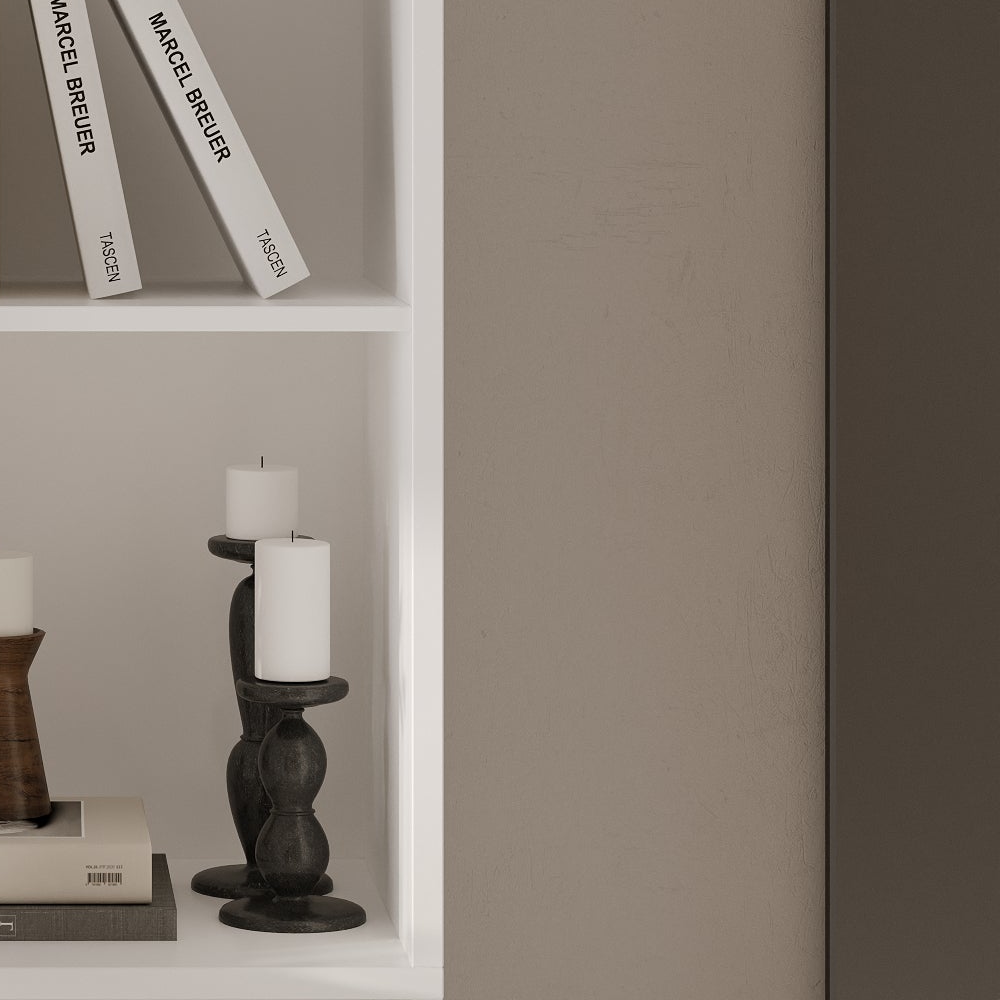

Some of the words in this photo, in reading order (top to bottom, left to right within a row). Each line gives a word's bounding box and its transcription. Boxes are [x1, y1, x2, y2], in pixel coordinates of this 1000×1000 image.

[66, 77, 96, 156] BREUER
[148, 11, 193, 88] MARCEL
[185, 87, 231, 163] BREUER
[99, 231, 121, 283] TASCEN
[256, 228, 288, 279] TASCEN
